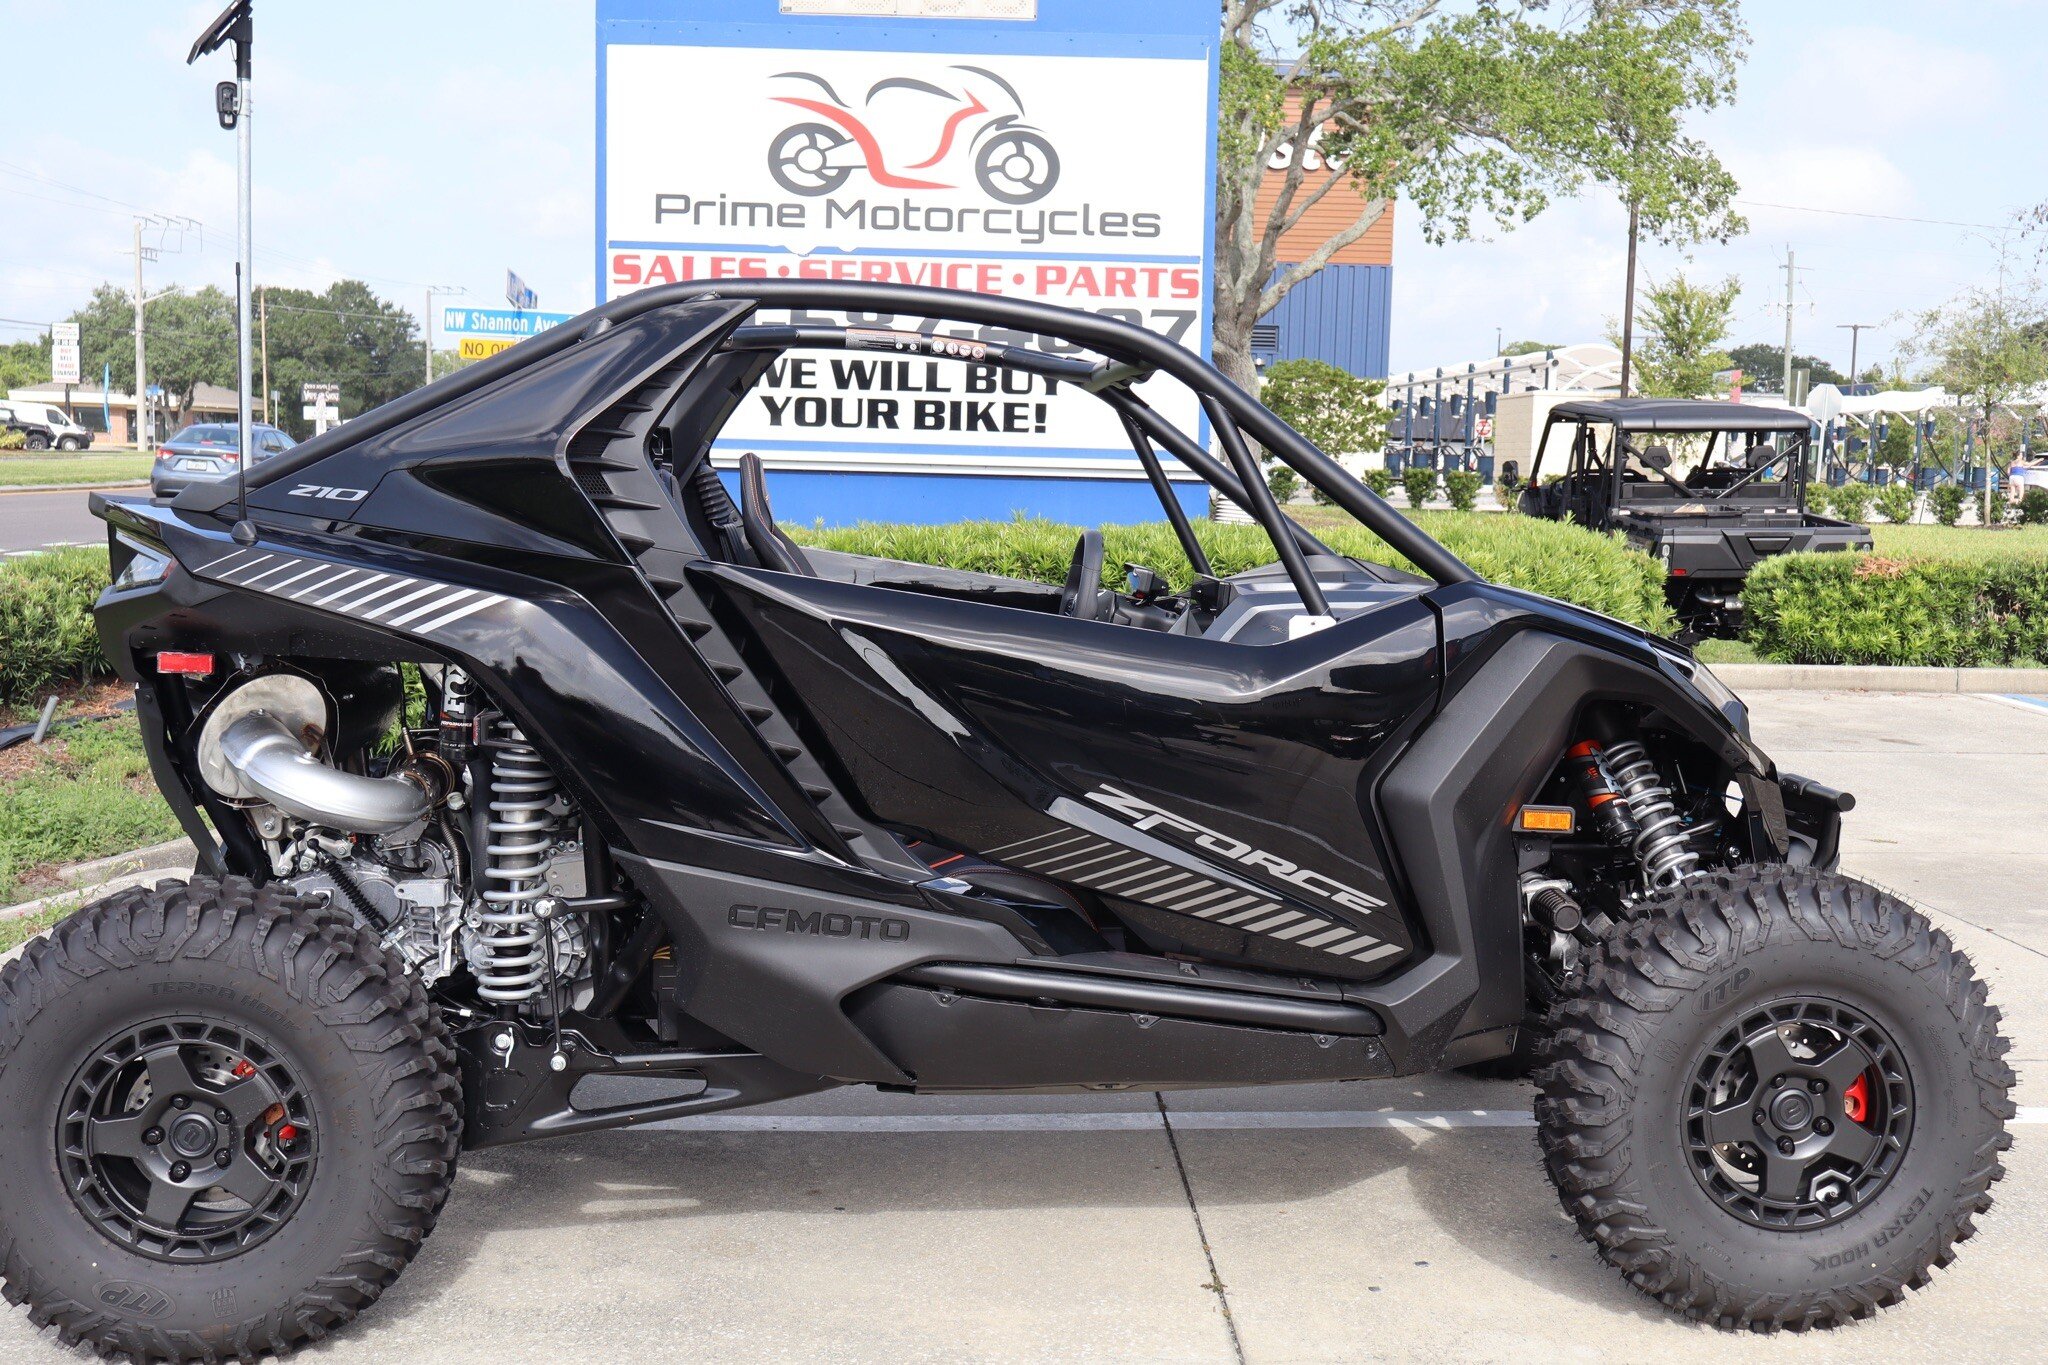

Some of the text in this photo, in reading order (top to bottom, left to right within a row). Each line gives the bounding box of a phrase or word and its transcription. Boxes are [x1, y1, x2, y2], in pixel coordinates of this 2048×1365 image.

[655, 193, 1162, 245] Prime Motorcycles
[1036, 266, 1200, 299] PARTS
[445, 310, 467, 330] NW
[471, 311, 529, 333] Shannon
[464, 342, 485, 356] NO
[830, 359, 952, 393] WILL
[760, 396, 1048, 434] YOUR BIKE!
[287, 483, 370, 502] Z10
[1084, 782, 1389, 916] ZFORCE
[727, 903, 911, 943] CFMOTO
[1702, 967, 1752, 1012] ITP
[1807, 1186, 1935, 1273] TERRA HOOK
[99, 1285, 169, 1317] ITP
